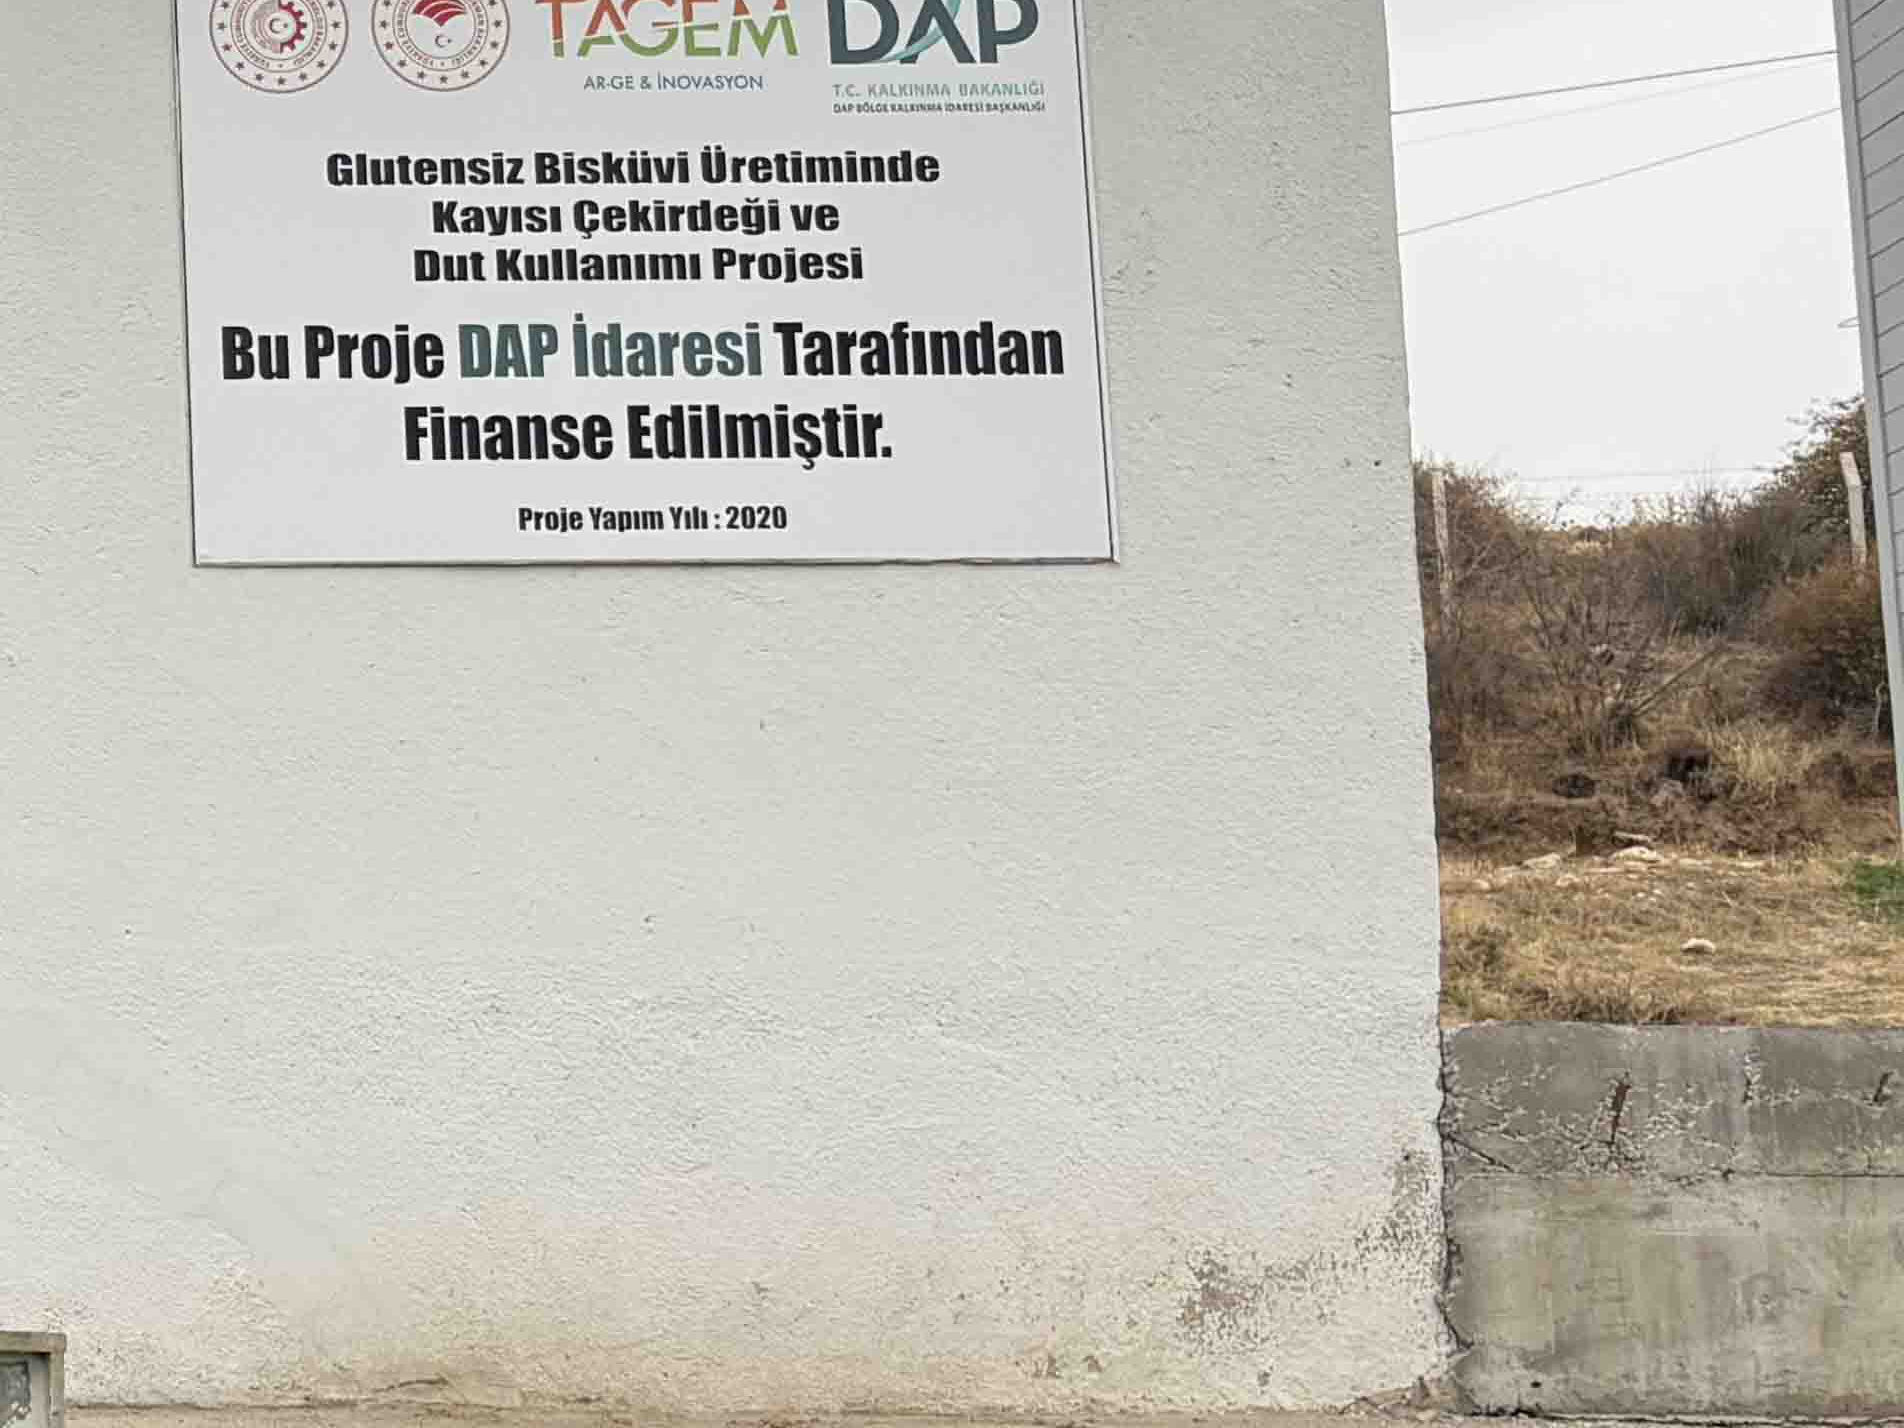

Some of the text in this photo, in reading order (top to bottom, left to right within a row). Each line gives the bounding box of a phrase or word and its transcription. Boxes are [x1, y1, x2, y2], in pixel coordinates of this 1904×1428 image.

[583, 71, 763, 90] AR-GE & İNOVASYON
[832, 80, 1044, 97] T.C. KALKINMA BAKANLIĞI
[833, 102, 854, 113] DAP
[327, 145, 939, 186] Glutensiz Bisküvi Üretiminde
[433, 198, 839, 239] Kayısı Çekirdeği ve
[414, 247, 863, 283] Dut Kullanımı Projesi
[222, 313, 1064, 384] Bu Proje DAP İdaresi Tarafından
[404, 404, 892, 470] Finanse Edilmiştir.
[519, 506, 787, 532] Proje Yapım Yılı : 2020
